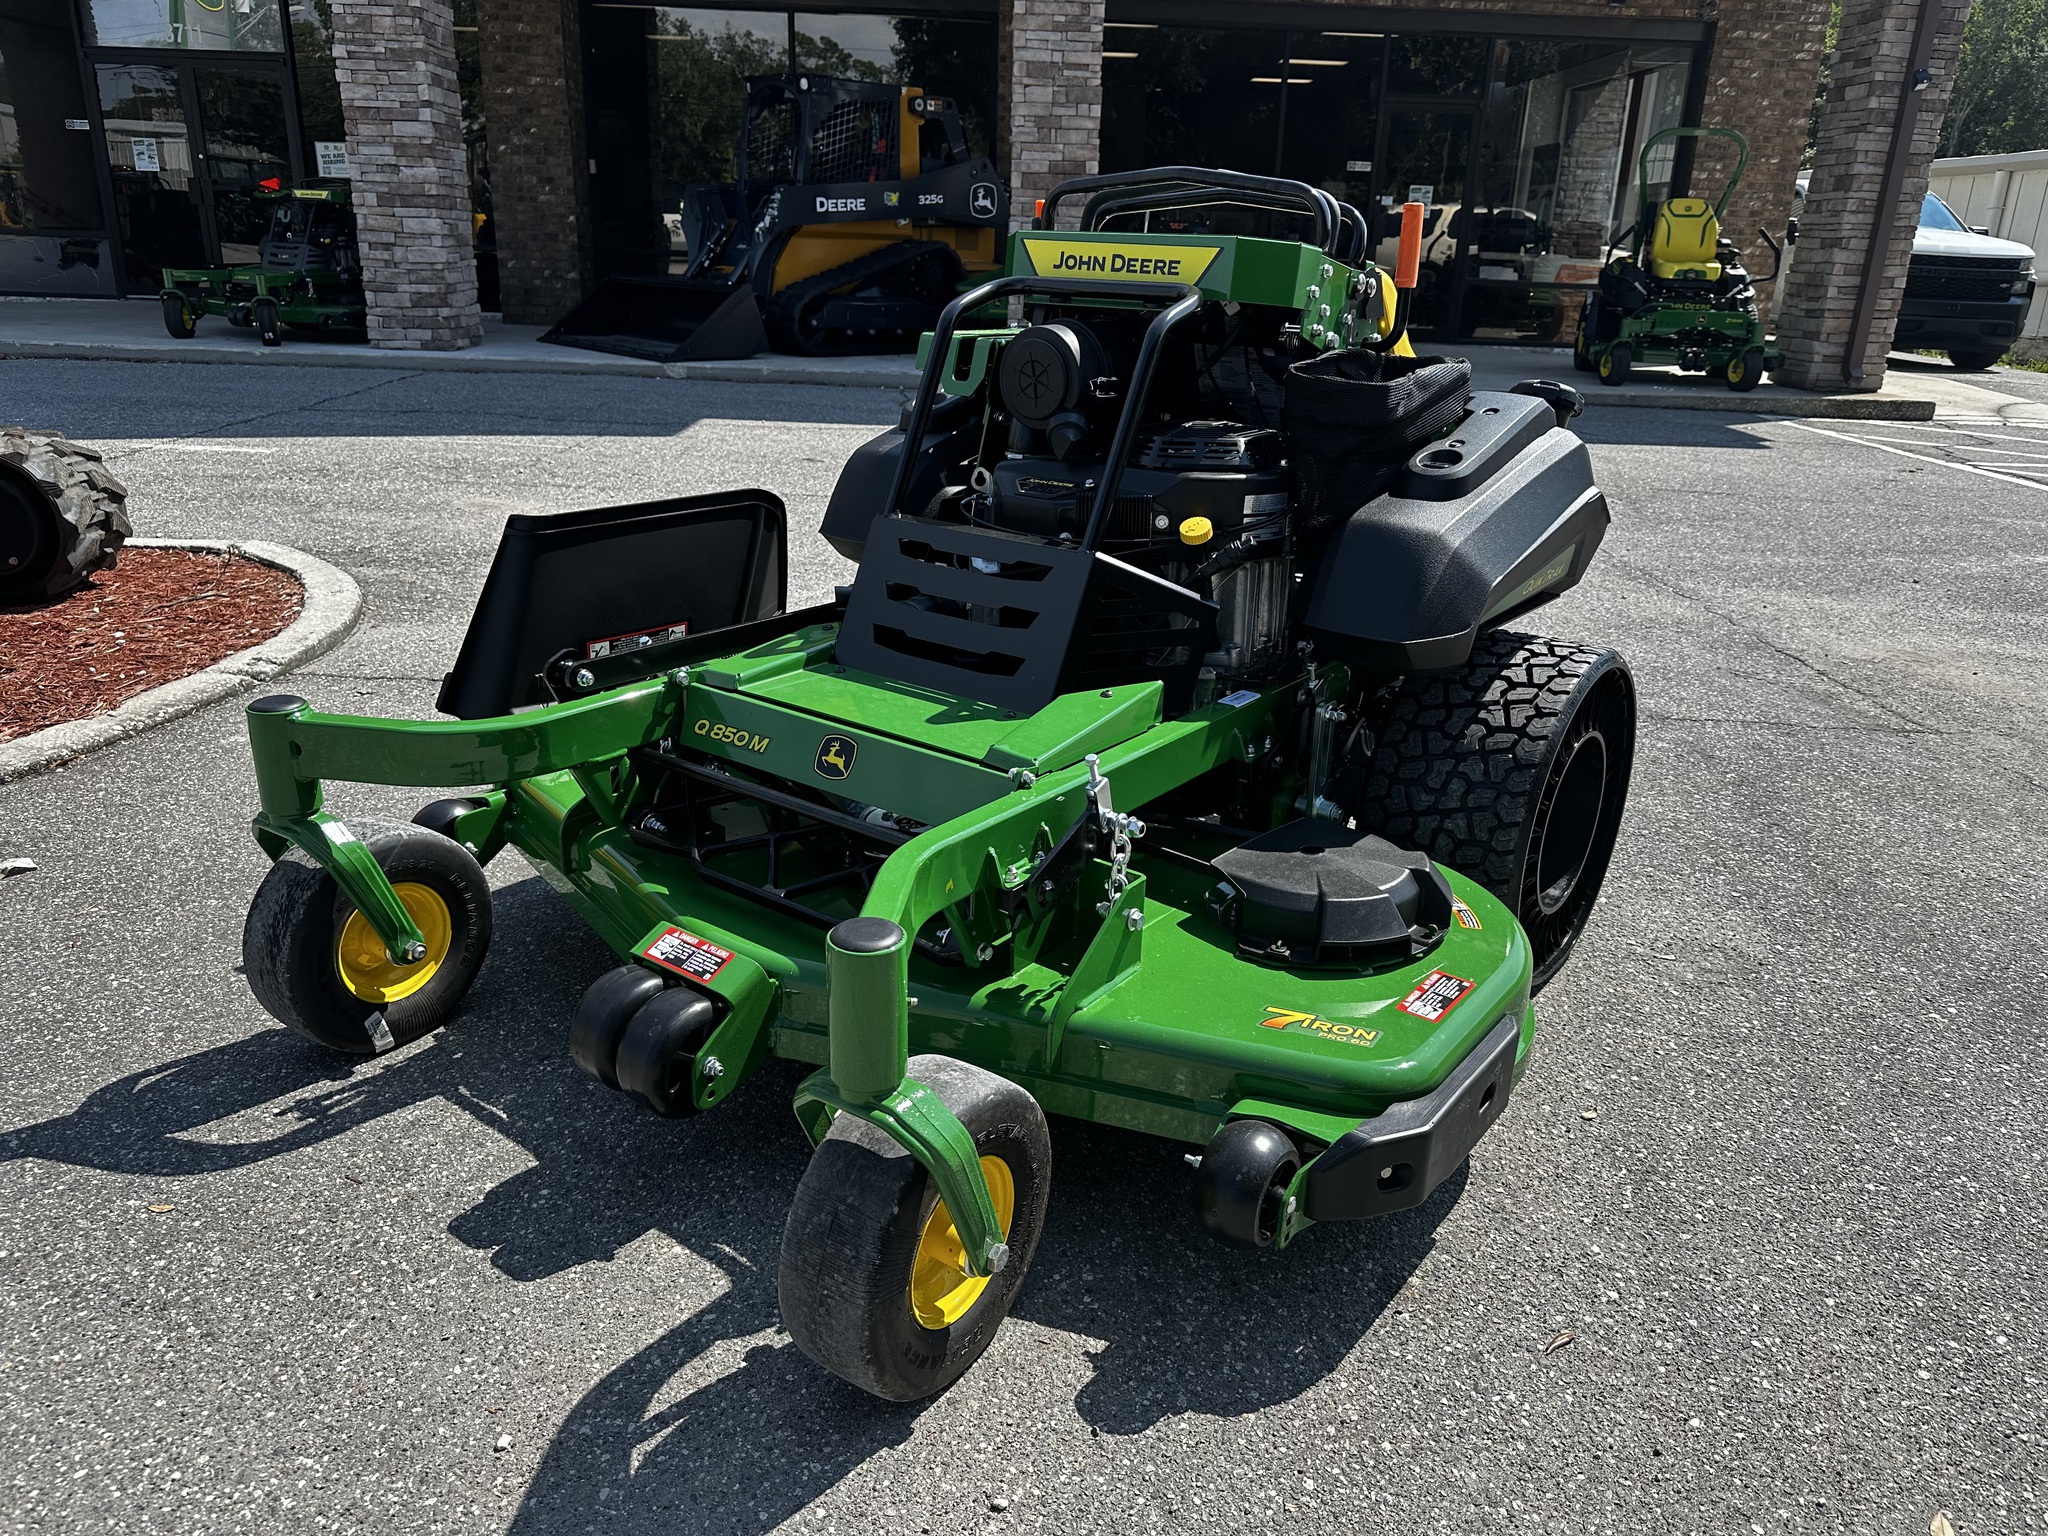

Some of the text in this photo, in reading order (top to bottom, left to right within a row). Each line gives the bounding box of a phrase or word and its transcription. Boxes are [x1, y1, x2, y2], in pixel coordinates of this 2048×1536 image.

[165, 22, 202, 44] 3711
[815, 196, 866, 213] DEERE
[918, 194, 944, 205] 325G
[1053, 250, 1181, 276] JOHN DEERE
[1048, 480, 1075, 488] DEERE
[694, 719, 770, 753] Q 850 M
[1317, 1032, 1347, 1042] PRO
